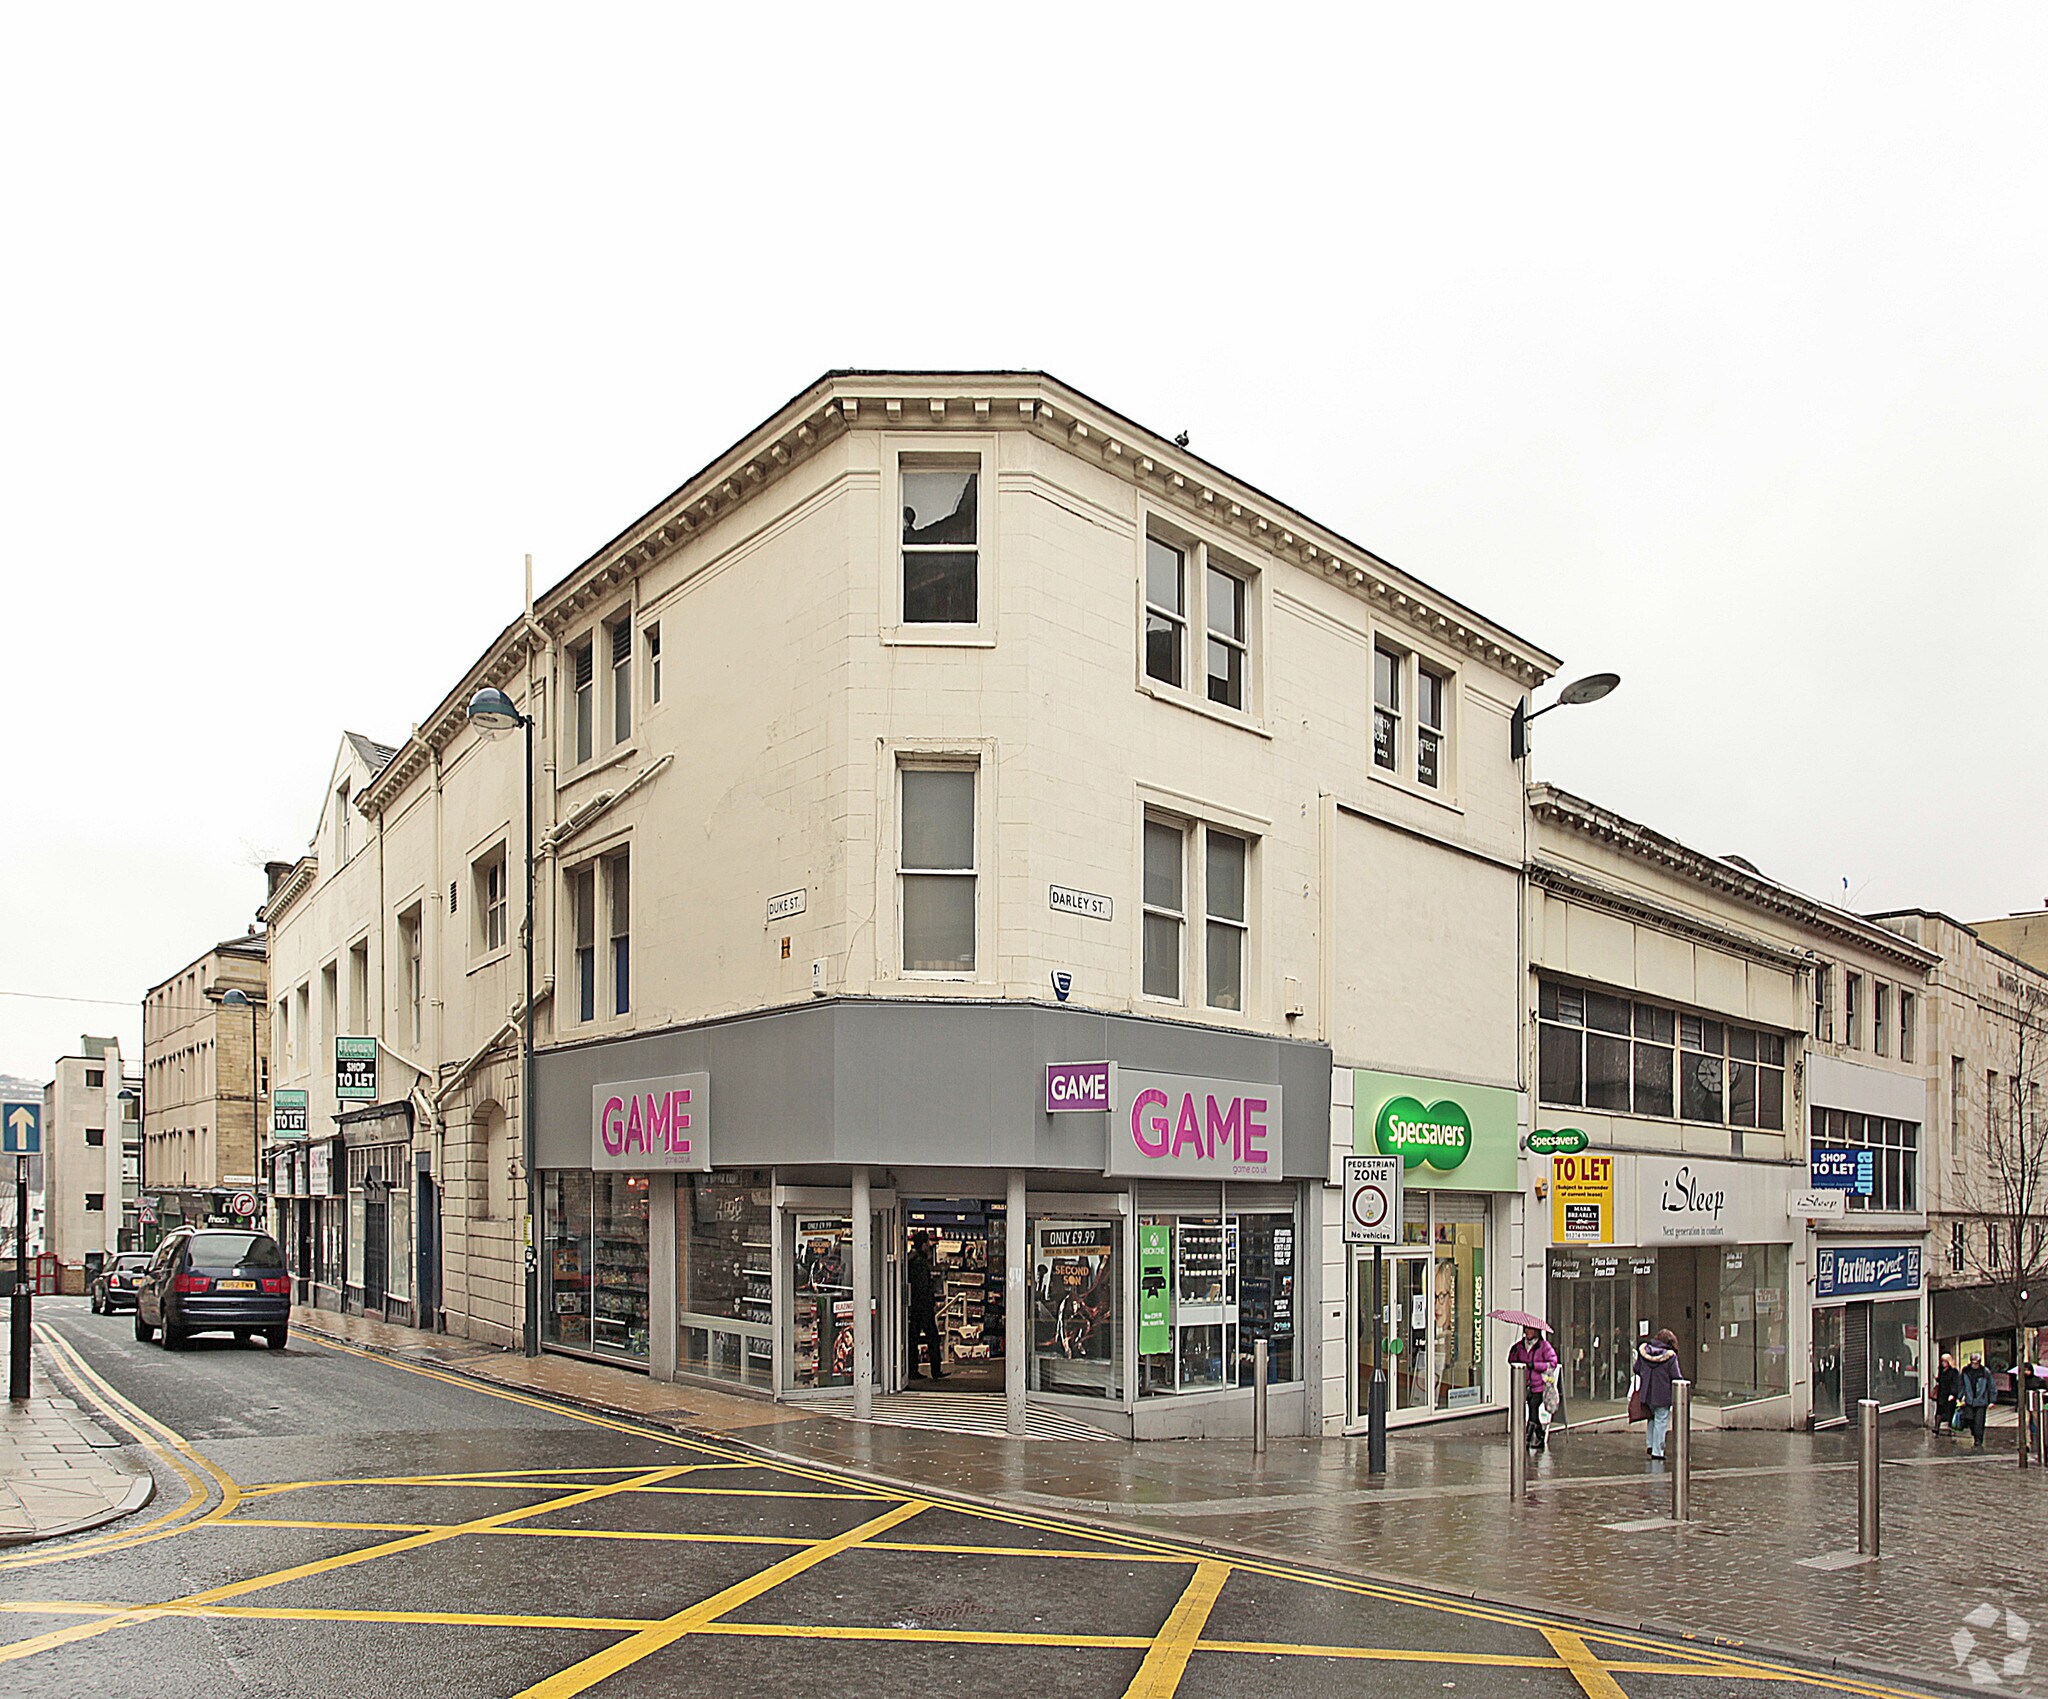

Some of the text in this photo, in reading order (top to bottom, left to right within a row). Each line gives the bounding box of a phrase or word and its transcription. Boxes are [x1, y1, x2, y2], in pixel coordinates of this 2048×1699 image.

[769, 899, 788, 915] DUKE
[1052, 891, 1105, 913] DARLEY ST.
[346, 1062, 366, 1072] SHOP
[338, 1073, 374, 1087] TO LET
[1051, 1074, 1106, 1100] GAME
[276, 1115, 305, 1129] TO LET
[601, 1088, 692, 1156] GAME
[1130, 1087, 1268, 1163] GAME
[1388, 1114, 1465, 1149] Specsavers
[1531, 1135, 1579, 1147] Specsavers
[1347, 1160, 1395, 1168] PEDESTRIAN
[1820, 1153, 1846, 1162] SHOP
[1232, 1164, 1267, 1175] game.co.uk
[1353, 1169, 1387, 1181] ZONE
[1554, 1157, 1610, 1181] TO LET
[1811, 1163, 1855, 1175] TO LET
[1661, 1166, 1724, 1221] iSleep
[1797, 1194, 1837, 1208] iSleep
[1049, 1230, 1095, 1245] ONLY £9.99
[1351, 1231, 1391, 1240] No vehicles
[1662, 1226, 1674, 1236] Next
[1675, 1226, 1700, 1239] generation
[1706, 1225, 1724, 1236] comfort
[1055, 1265, 1089, 1276] SECOND
[1551, 1270, 1561, 1278] Free
[1837, 1252, 1905, 1284] Textiles Direct
[1063, 1275, 1082, 1286] SON
[1473, 1275, 1483, 1363] Contact Lenses
